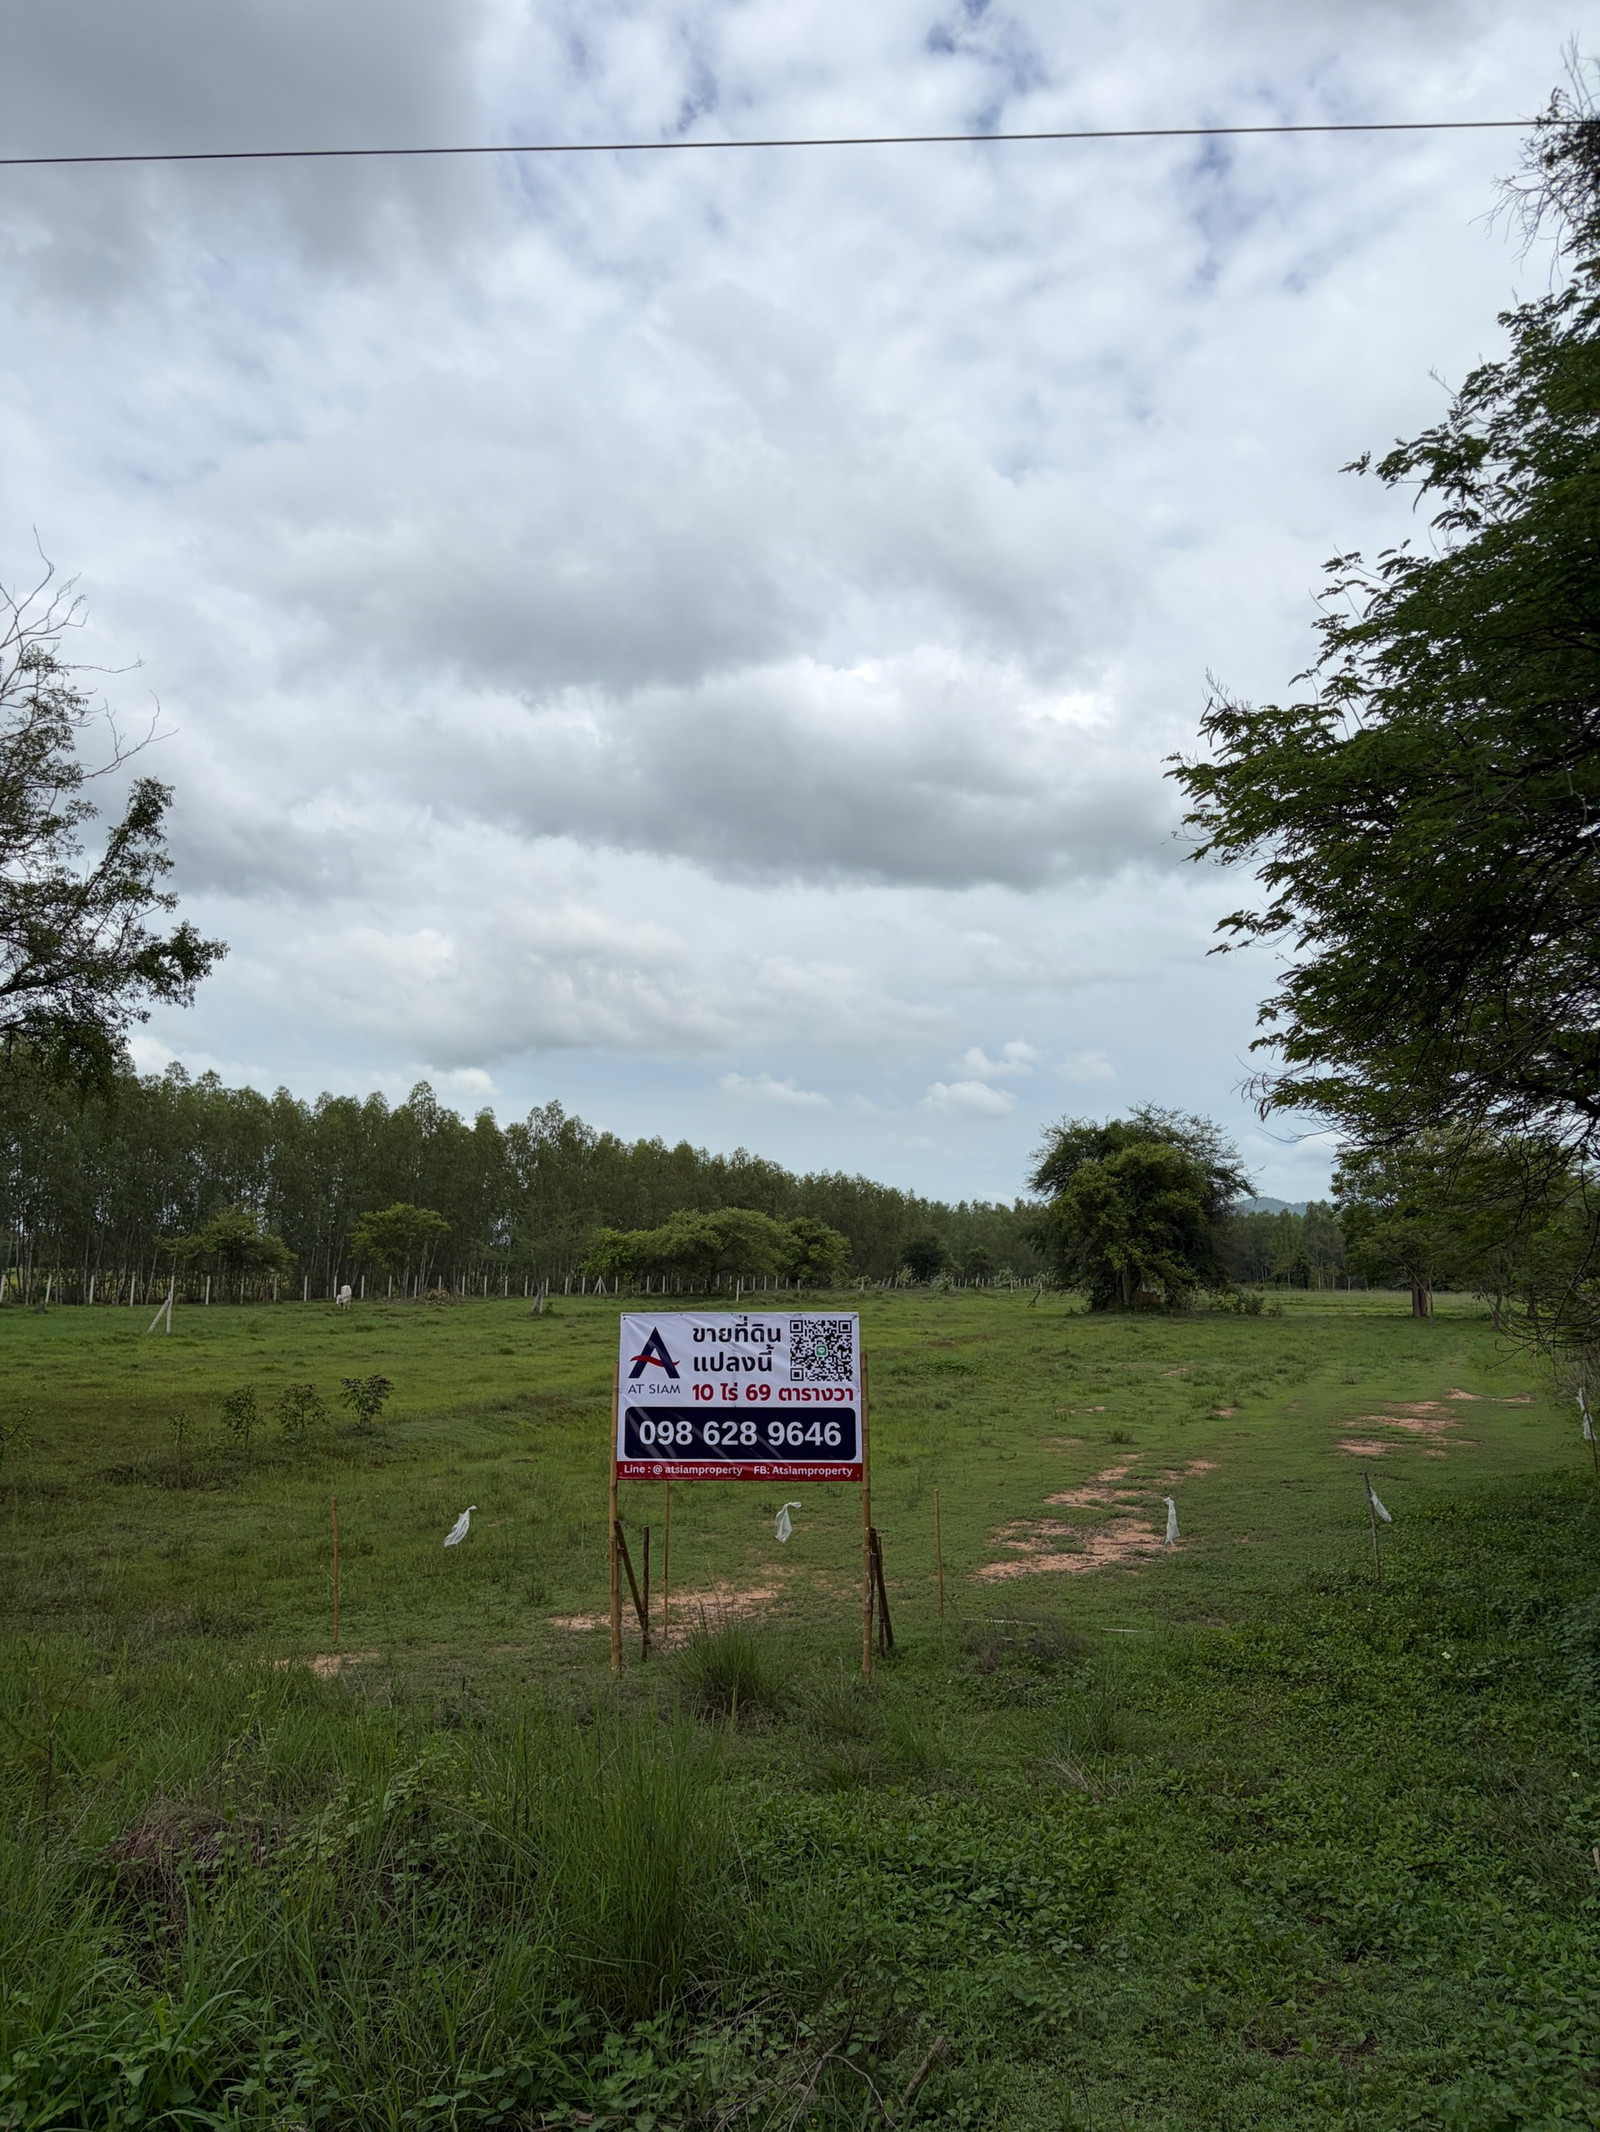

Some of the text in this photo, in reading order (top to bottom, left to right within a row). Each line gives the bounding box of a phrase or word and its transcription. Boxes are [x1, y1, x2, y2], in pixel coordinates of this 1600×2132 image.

[692, 1315, 781, 1343] ขายที่ดิน
[693, 1344, 774, 1372] แปลงนี้
[628, 1384, 681, 1394] AT SIAM
[692, 1382, 853, 1402] 10 ไร่ 69 ตารางวา
[639, 1421, 842, 1447] 098 628 9646
[624, 1465, 645, 1474] Line
[664, 1465, 743, 1477] atsiamproperty
[753, 1466, 853, 1477] FB: Atsiamproperty
